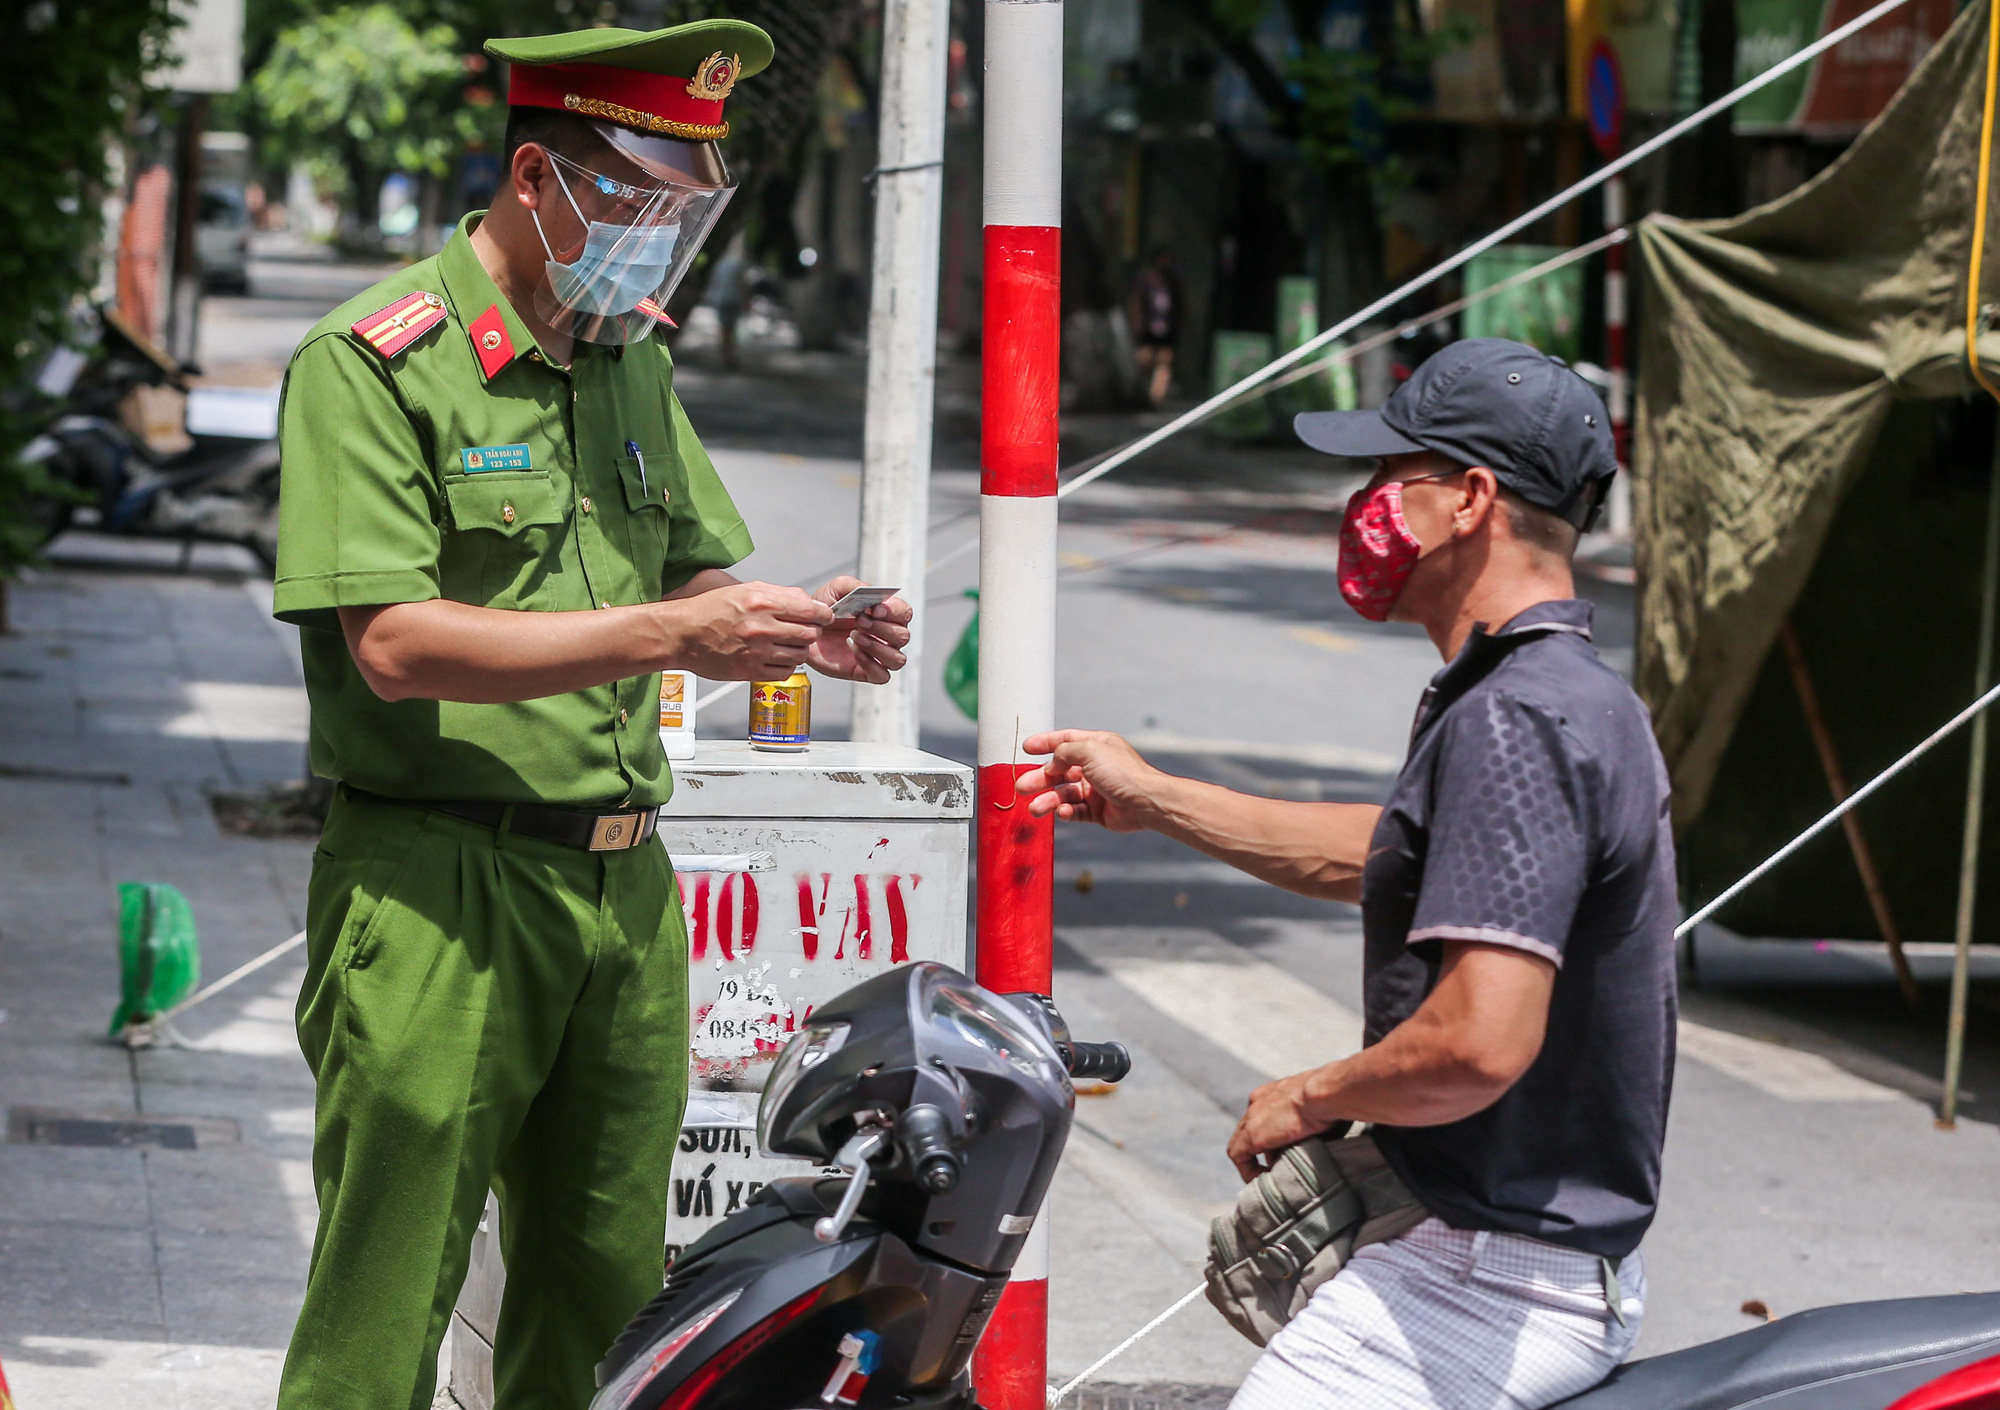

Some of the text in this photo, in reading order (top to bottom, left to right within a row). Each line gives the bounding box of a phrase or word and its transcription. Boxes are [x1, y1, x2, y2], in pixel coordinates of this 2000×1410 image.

[490, 460, 503, 468] 123
[509, 459, 522, 467] 153
[676, 1162, 713, 1218] VÁ
